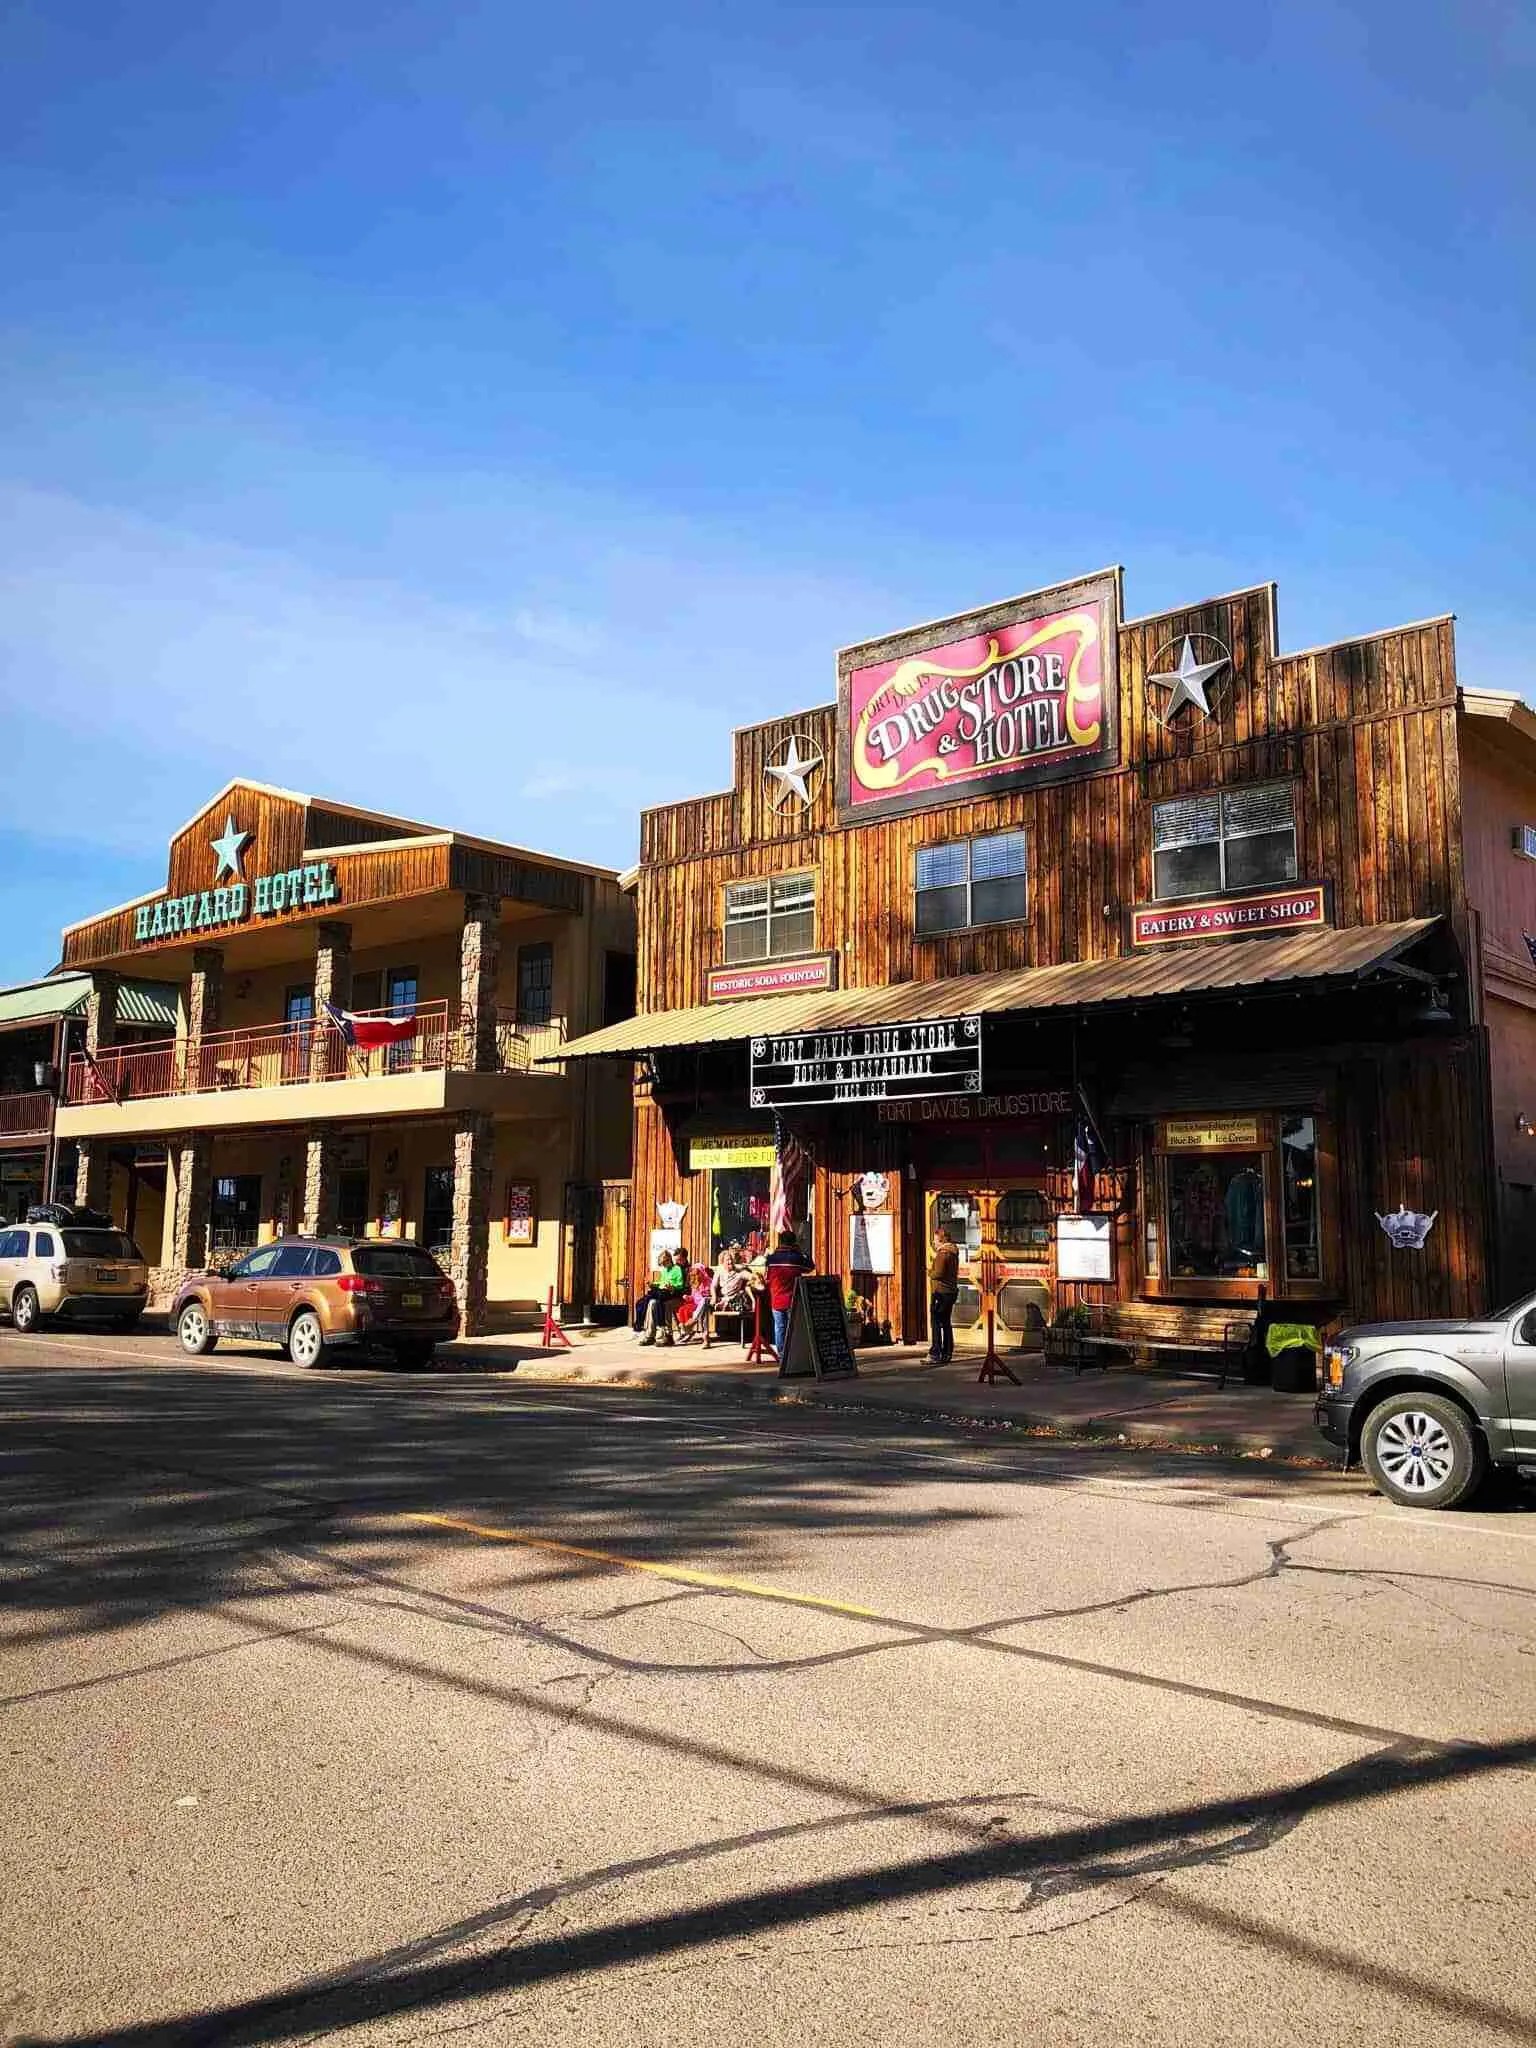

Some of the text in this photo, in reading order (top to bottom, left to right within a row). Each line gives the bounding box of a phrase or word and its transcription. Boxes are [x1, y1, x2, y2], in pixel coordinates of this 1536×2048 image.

[868, 653, 1066, 761] DRUG STORE
[938, 699, 1068, 765] & HOTEL
[135, 862, 336, 940] HARVARD HOTEL
[1139, 900, 1315, 936] EATERY & SWEET SHOP
[713, 967, 826, 992] HISTORIC SODA FOUNTAIN
[772, 1024, 956, 1064] FORT DAVIS DRUG STORE
[793, 1055, 933, 1084] HOTEL & RESTAURANT
[834, 1084, 860, 1100] SINCE
[878, 1091, 1073, 1121] FORT DAVIS DRUGSTORE
